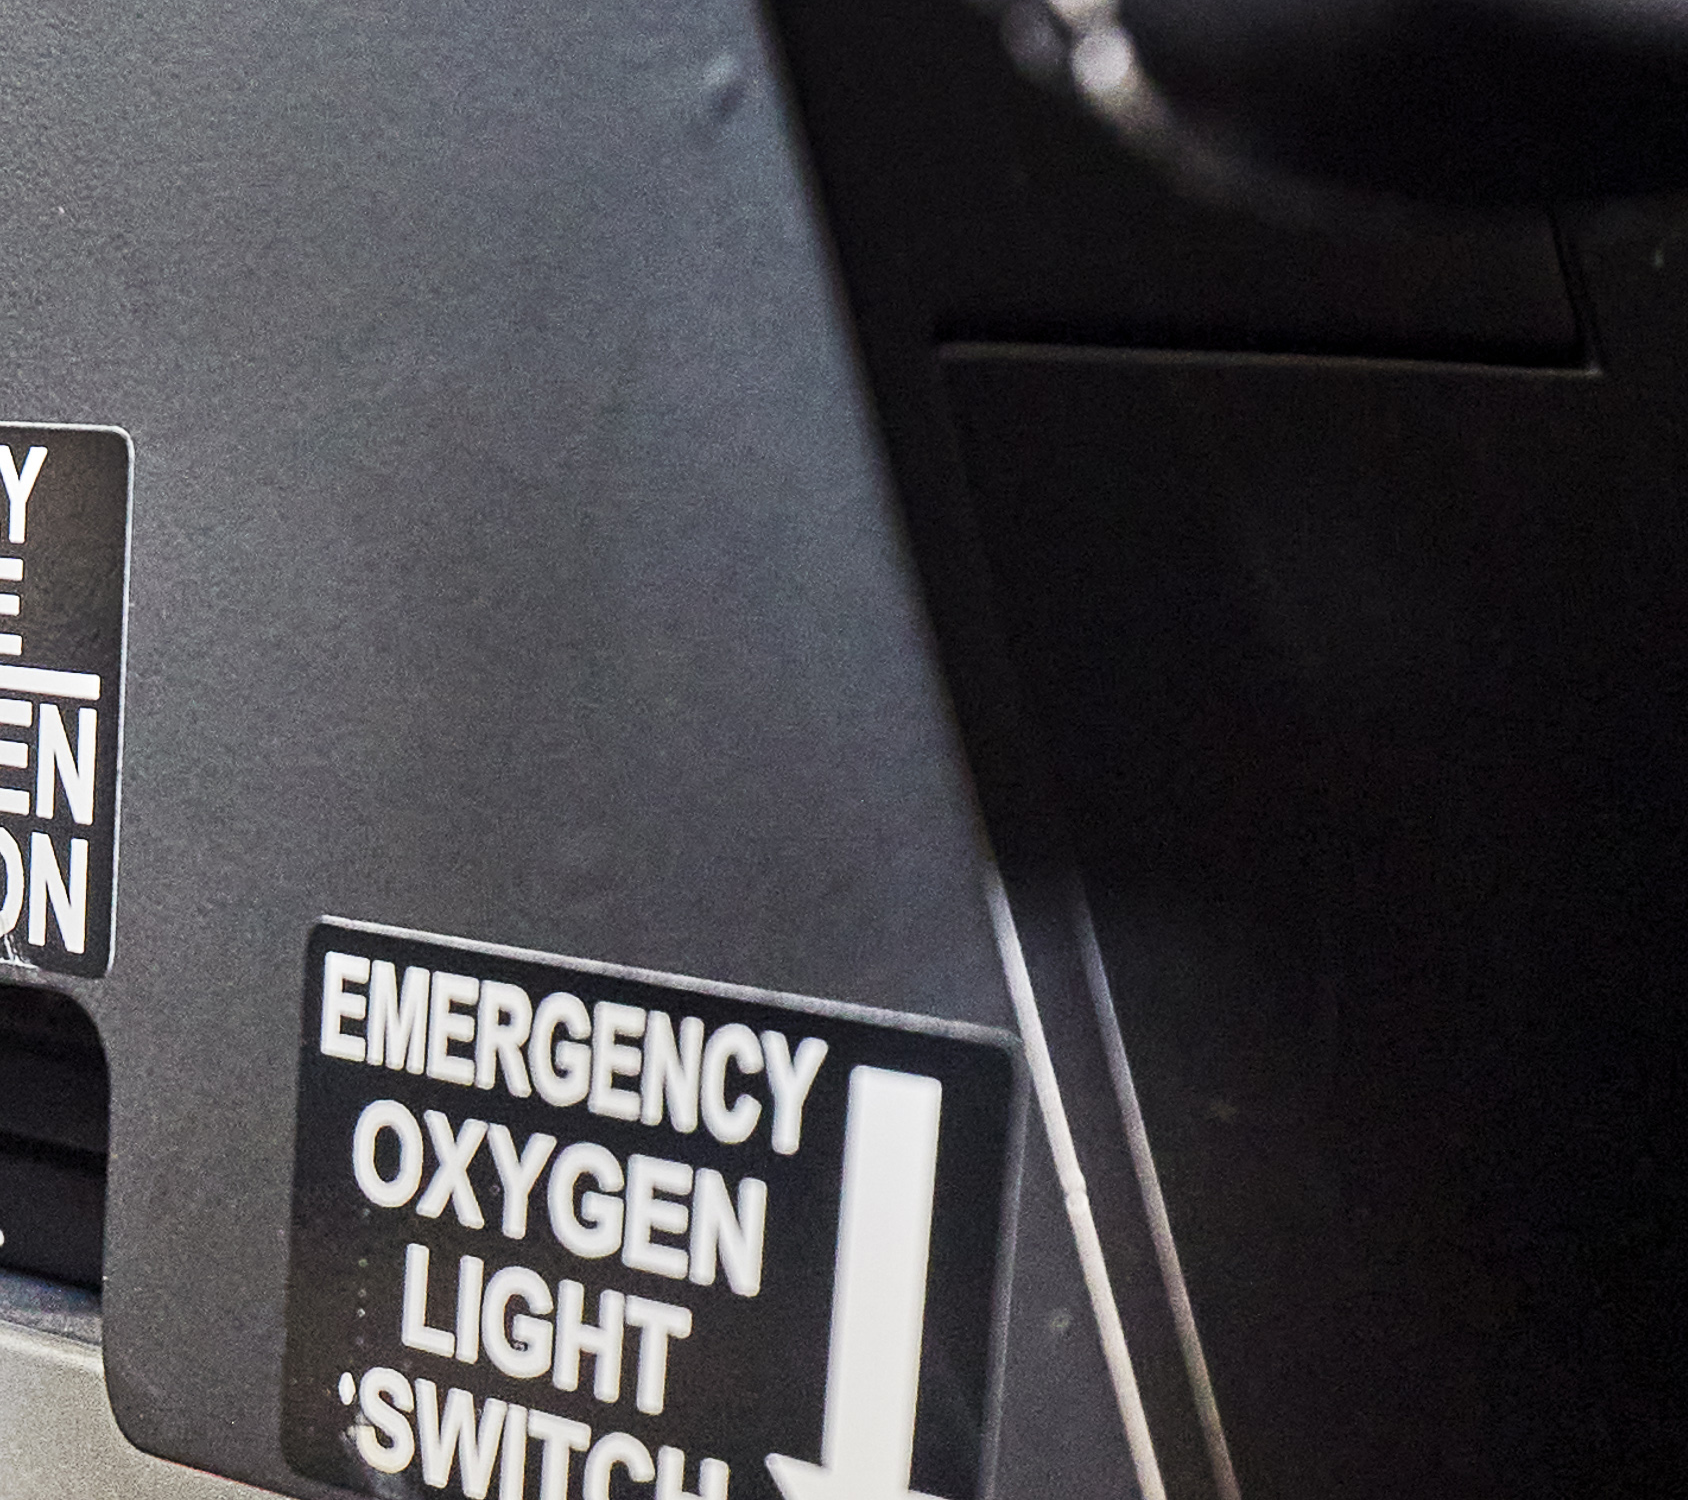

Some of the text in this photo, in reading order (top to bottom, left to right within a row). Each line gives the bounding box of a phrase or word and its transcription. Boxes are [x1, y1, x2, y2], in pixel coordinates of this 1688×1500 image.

[319, 950, 829, 1155] EMERGENCY
[352, 1099, 768, 1298] OXYGEN
[401, 1242, 693, 1416] LIGHT
